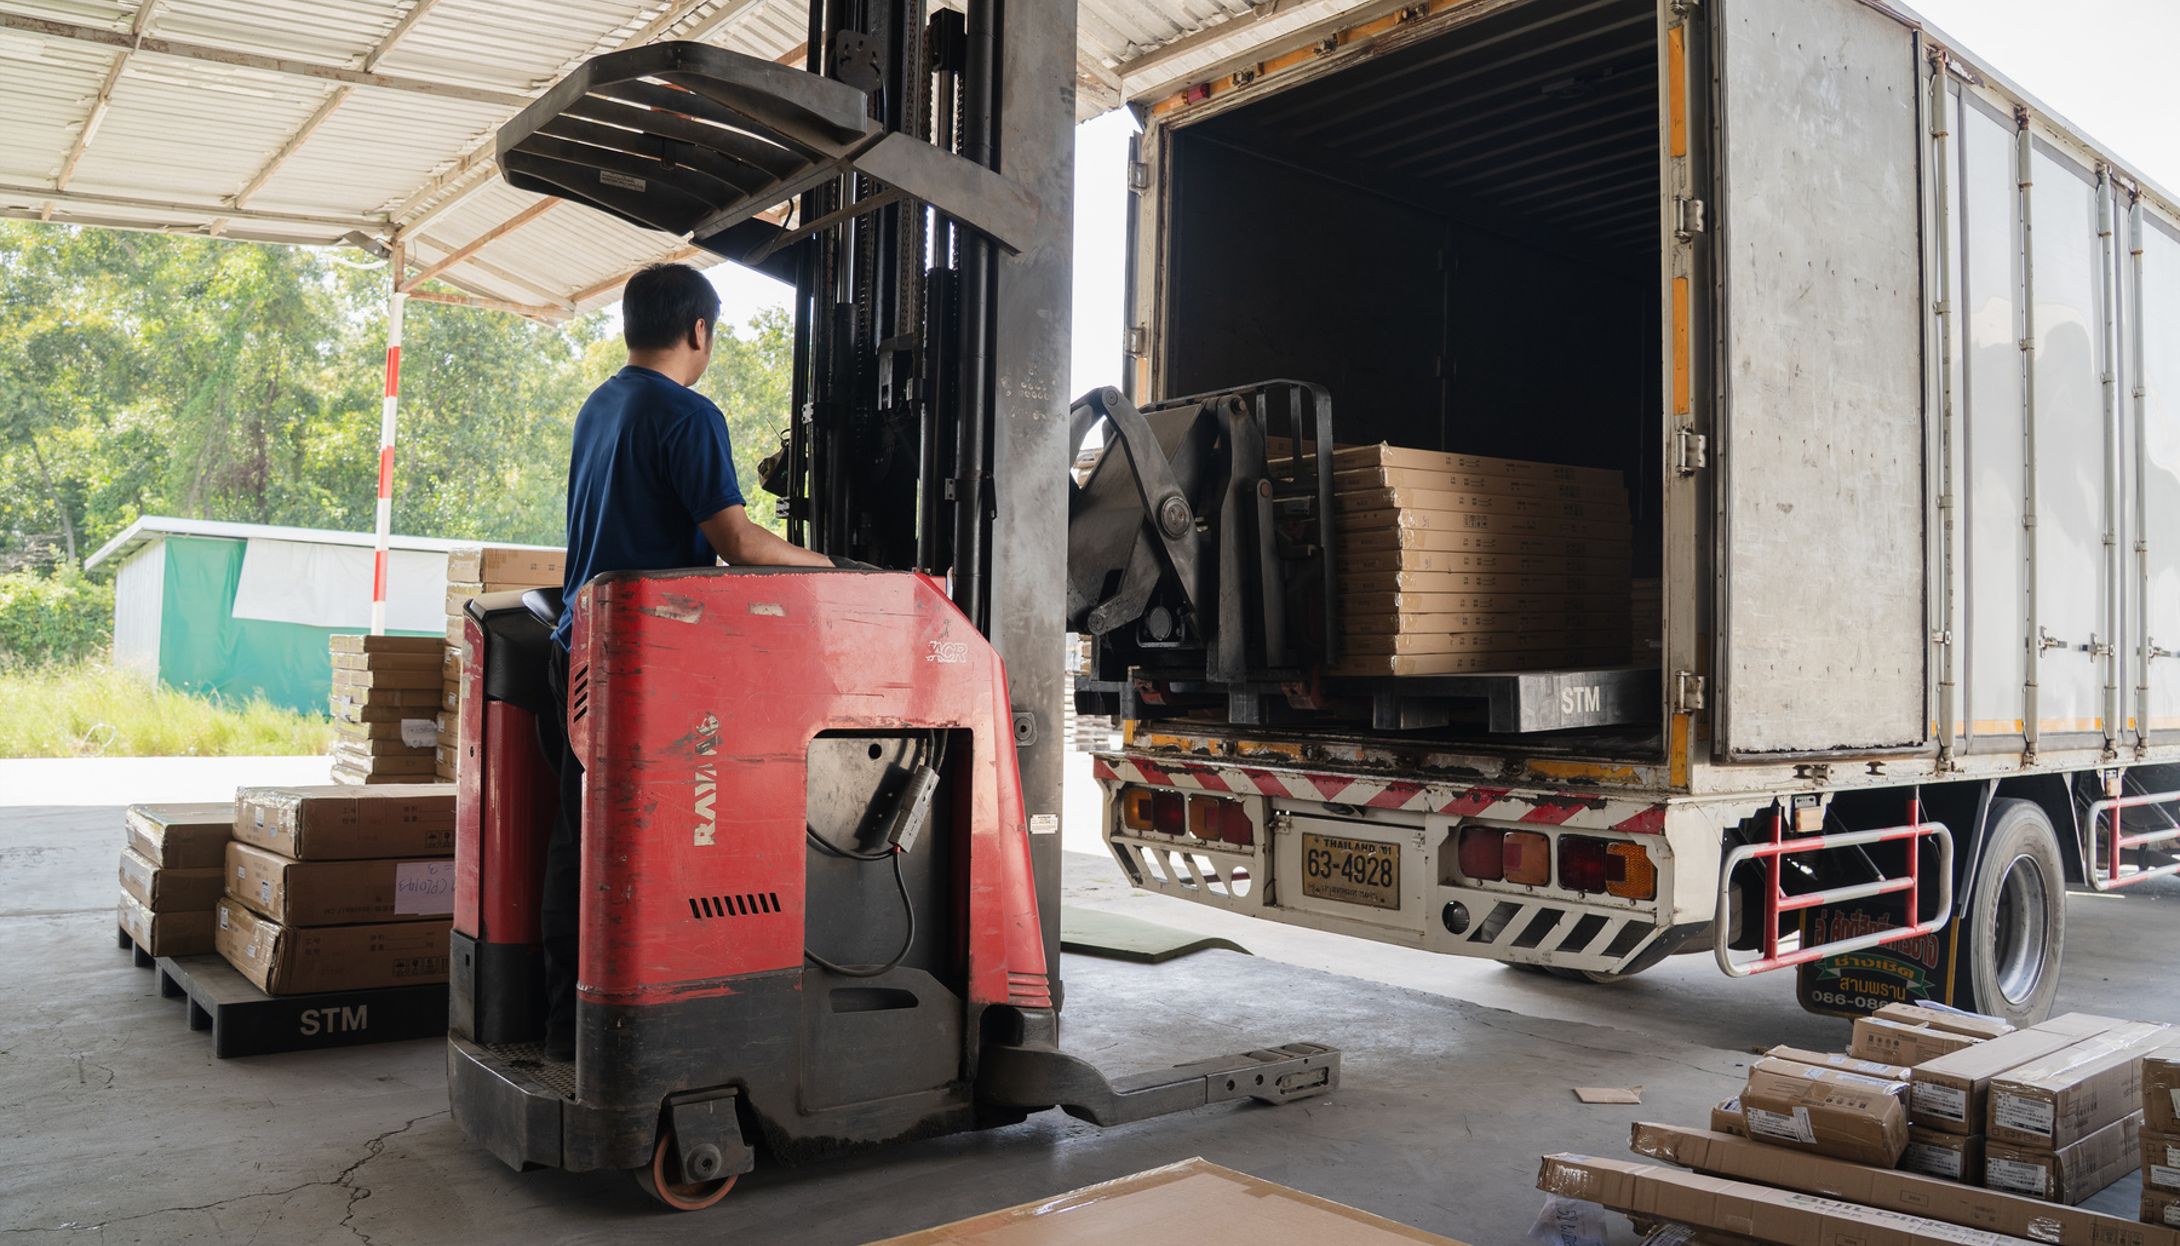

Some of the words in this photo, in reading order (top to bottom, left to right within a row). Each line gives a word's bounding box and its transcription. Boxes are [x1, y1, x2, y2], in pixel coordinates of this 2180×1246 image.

[1561, 686, 1600, 714] STM
[1323, 839, 1375, 853] THAILAND
[1308, 849, 1392, 887] 63-4928
[1840, 976, 1906, 1001] สามพราน
[300, 1004, 368, 1036] STM
